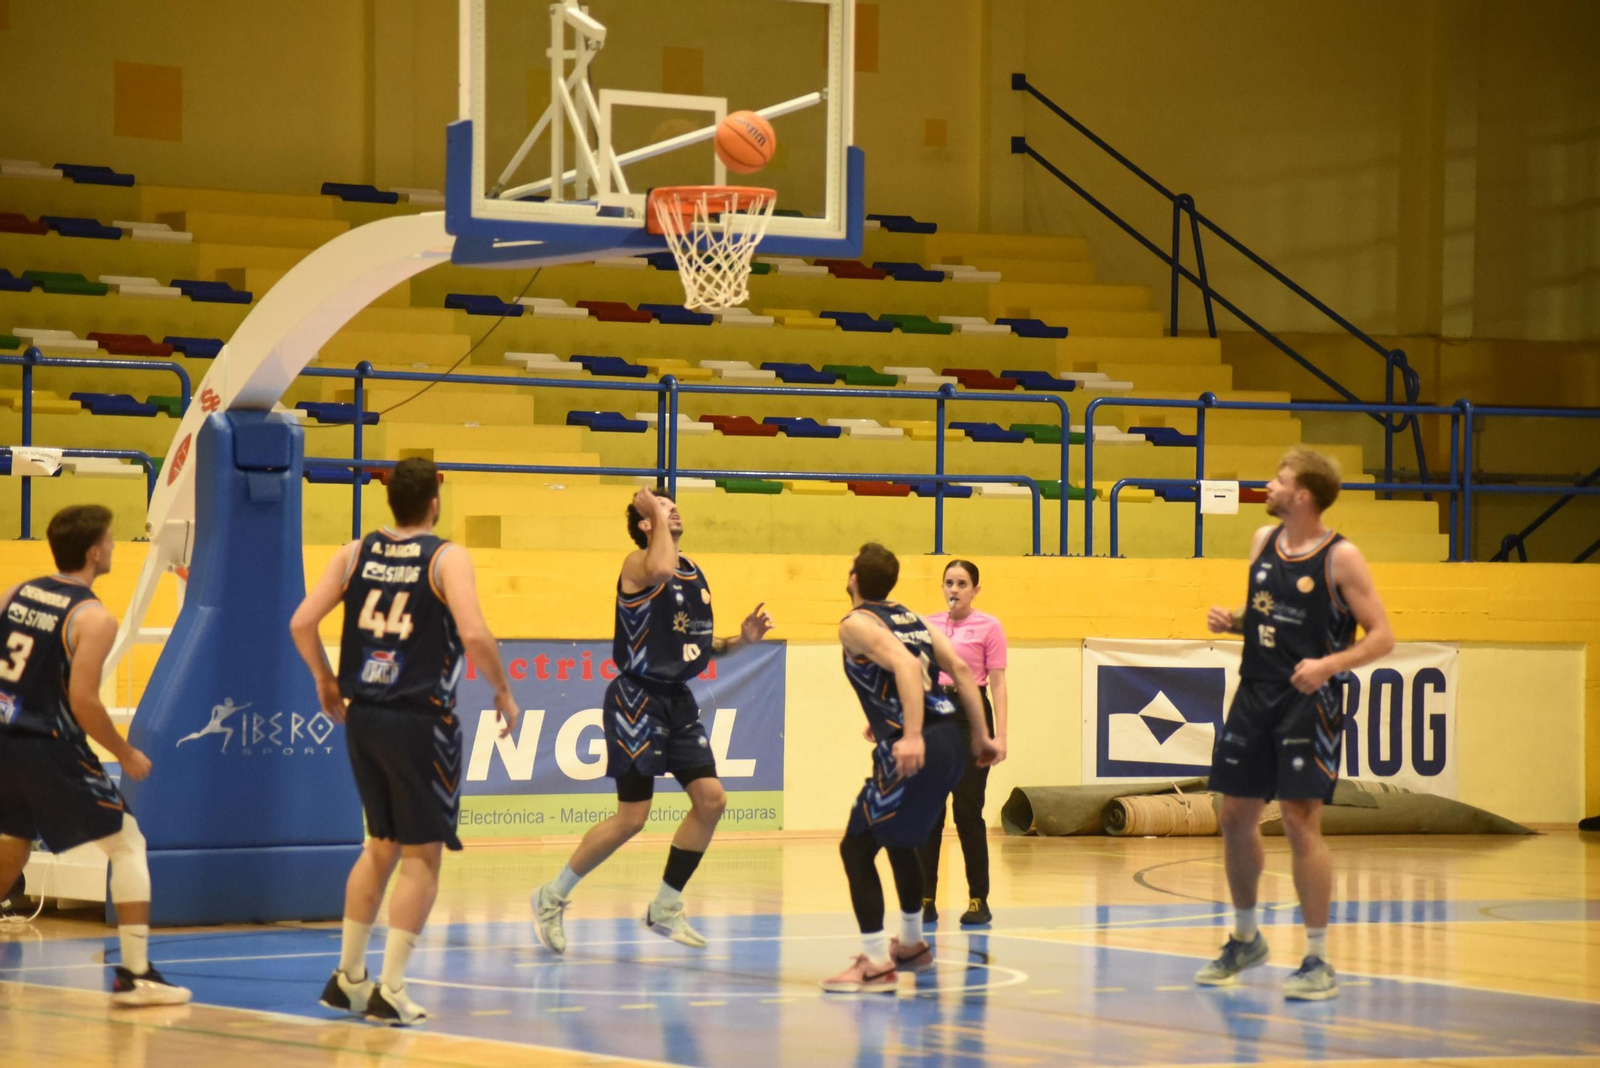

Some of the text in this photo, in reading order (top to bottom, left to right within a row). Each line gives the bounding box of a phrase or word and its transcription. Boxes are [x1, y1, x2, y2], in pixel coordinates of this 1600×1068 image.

[358, 588, 414, 640] 44
[1258, 623, 1276, 648] 15
[0, 631, 34, 682] 3
[683, 643, 701, 662] 10
[242, 711, 334, 746] IBERO
[242, 747, 333, 755] SPORT
[459, 809, 544, 825] Electrónica
[561, 807, 616, 824] Materia
[722, 807, 777, 824] mparas
